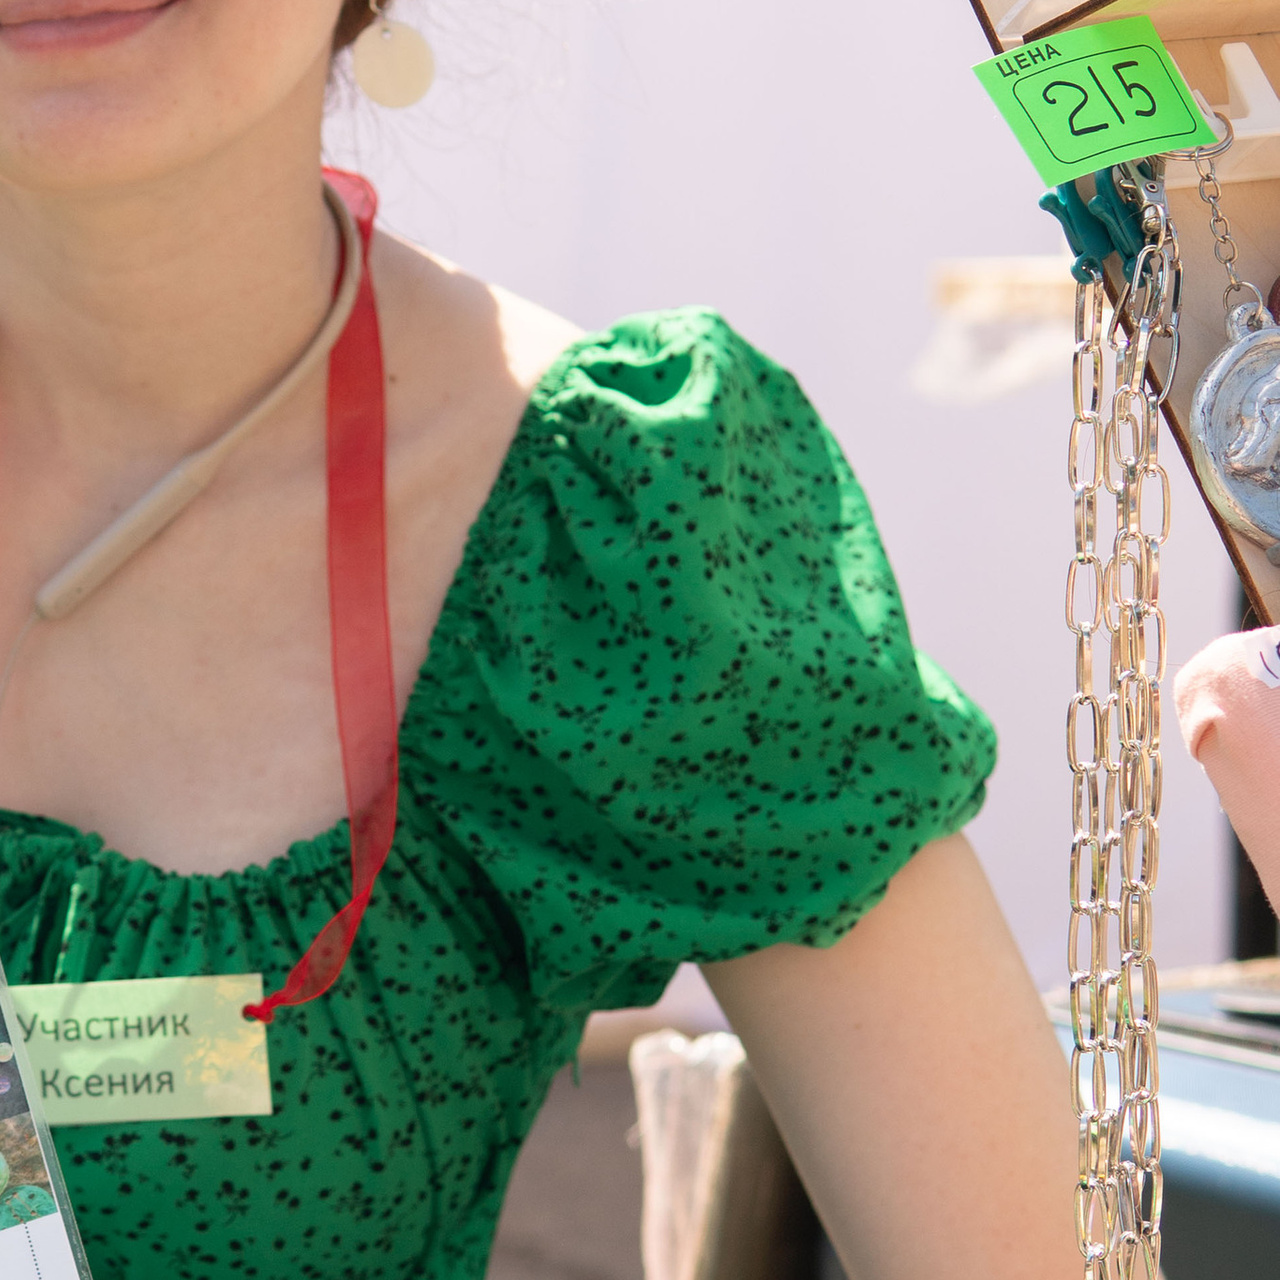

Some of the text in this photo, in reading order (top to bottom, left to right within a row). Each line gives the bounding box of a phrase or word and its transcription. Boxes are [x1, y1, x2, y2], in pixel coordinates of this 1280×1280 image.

[995, 42, 1062, 79] ЦЕНА
[1041, 60, 1157, 137] 215
[14, 1012, 192, 1043] Участник
[39, 1068, 176, 1100] Ксения
